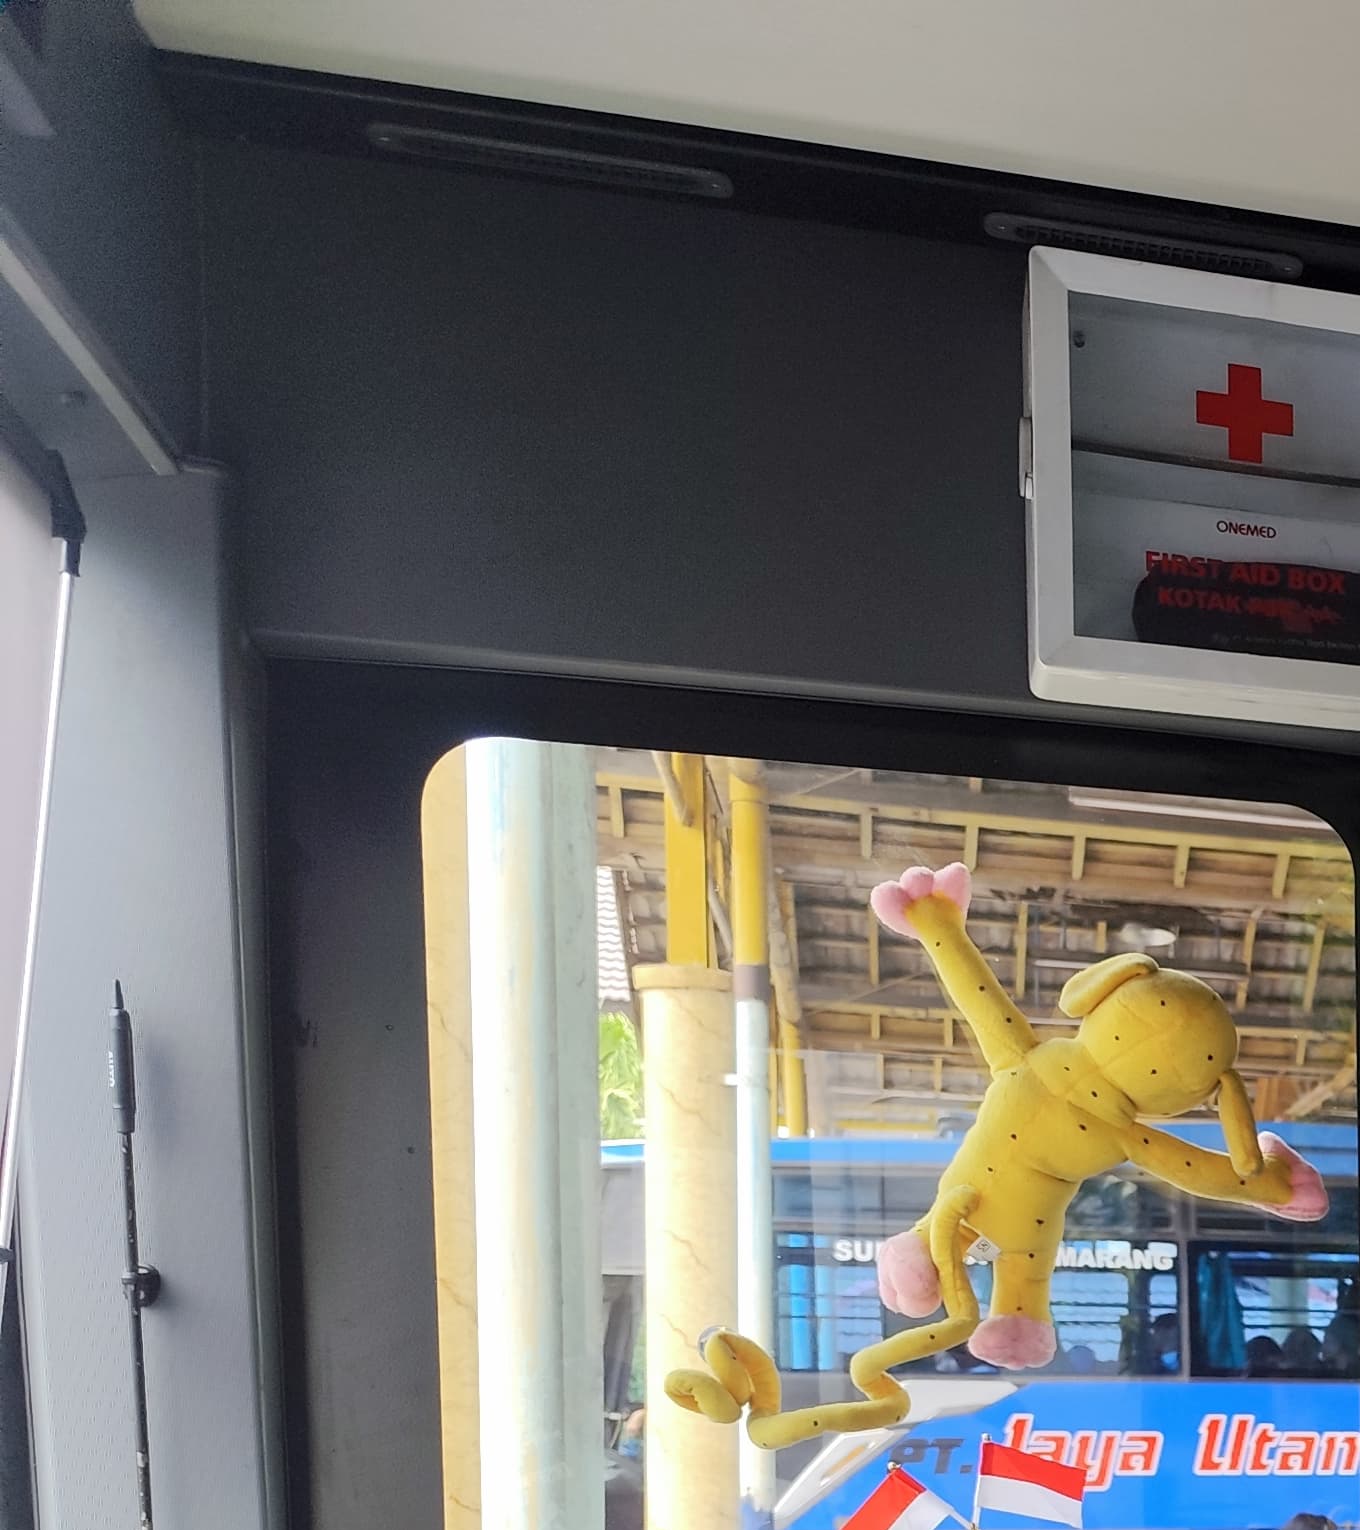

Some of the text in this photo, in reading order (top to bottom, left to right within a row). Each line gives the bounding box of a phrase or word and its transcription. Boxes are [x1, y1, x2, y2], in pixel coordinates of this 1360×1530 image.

[1216, 520, 1277, 539] ONEMED
[1145, 550, 1346, 594] FIRST AID BOX
[1157, 587, 1241, 613] KOTAK
